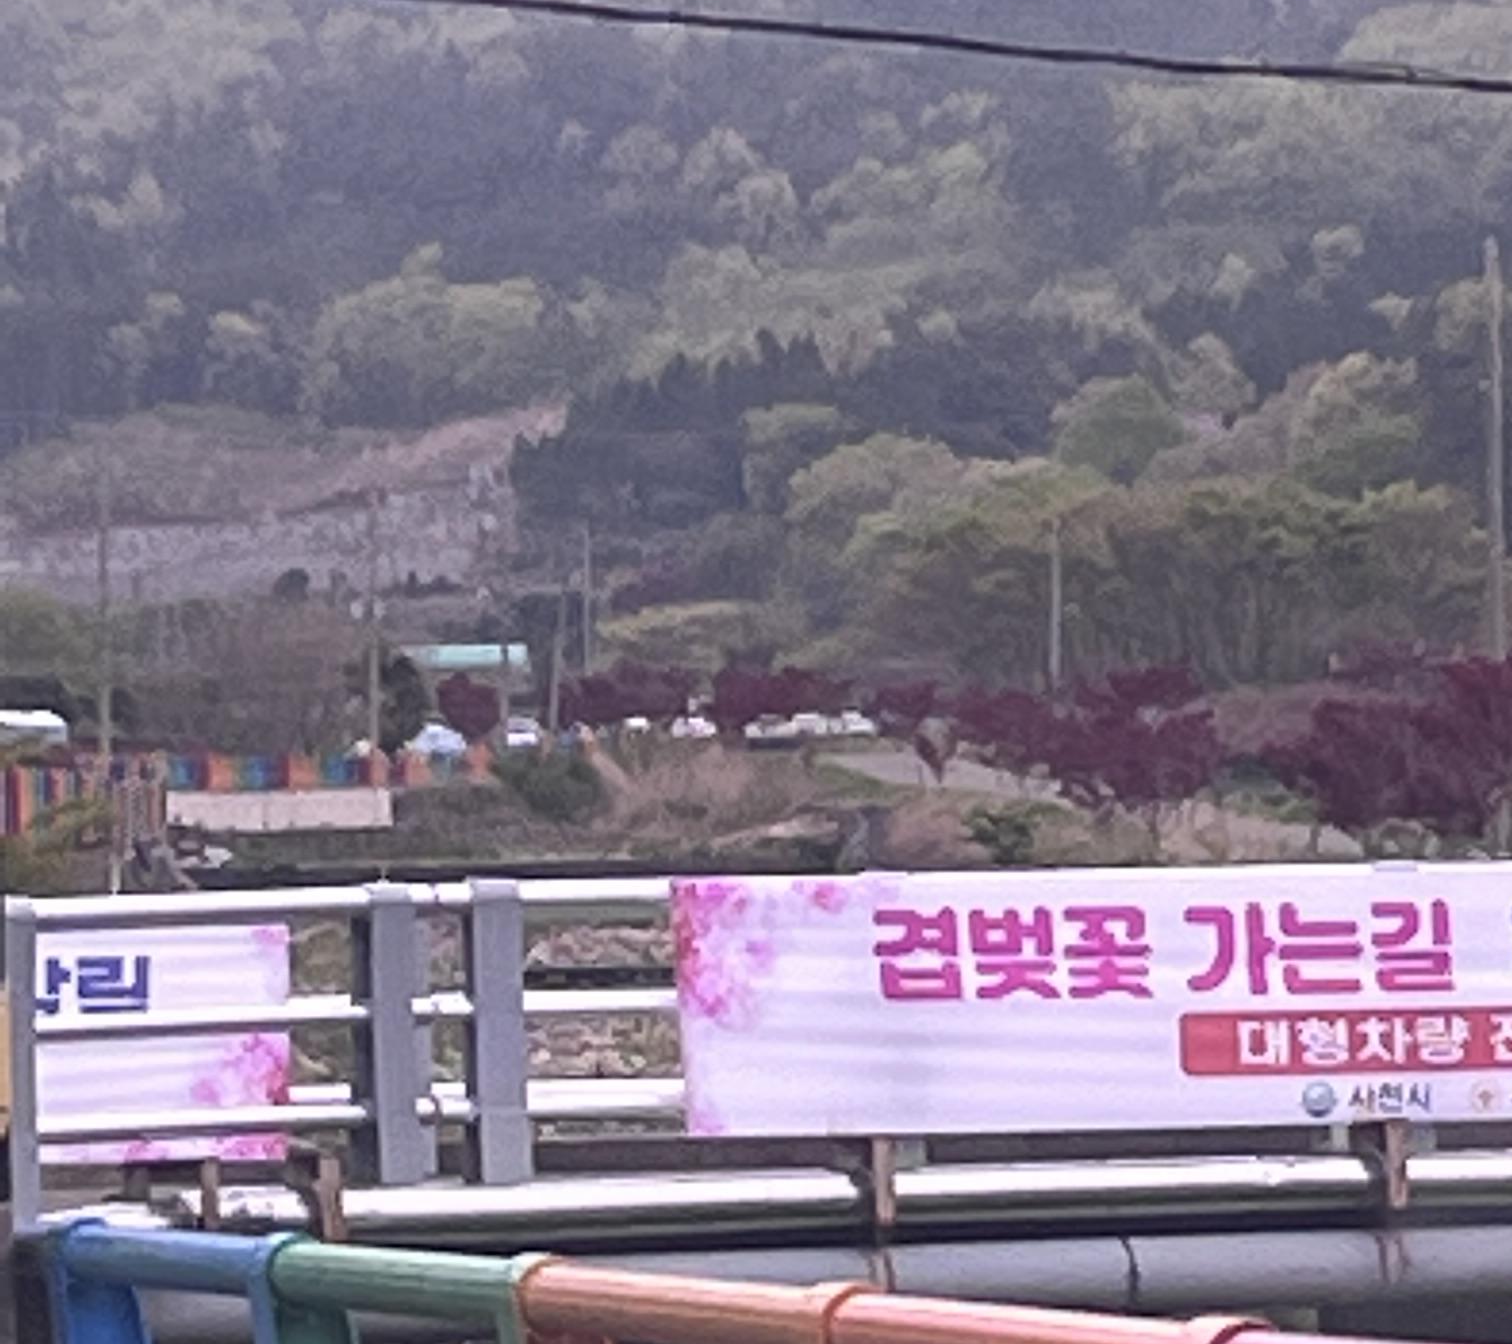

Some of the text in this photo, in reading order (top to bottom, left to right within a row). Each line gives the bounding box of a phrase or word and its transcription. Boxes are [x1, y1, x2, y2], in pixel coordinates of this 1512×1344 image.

[873, 905, 1154, 1003] 겹벚꽃
[1184, 898, 1455, 996] 가는길
[1236, 1015, 1470, 1066] 대형차량
[1347, 1082, 1432, 1114] 사천시
